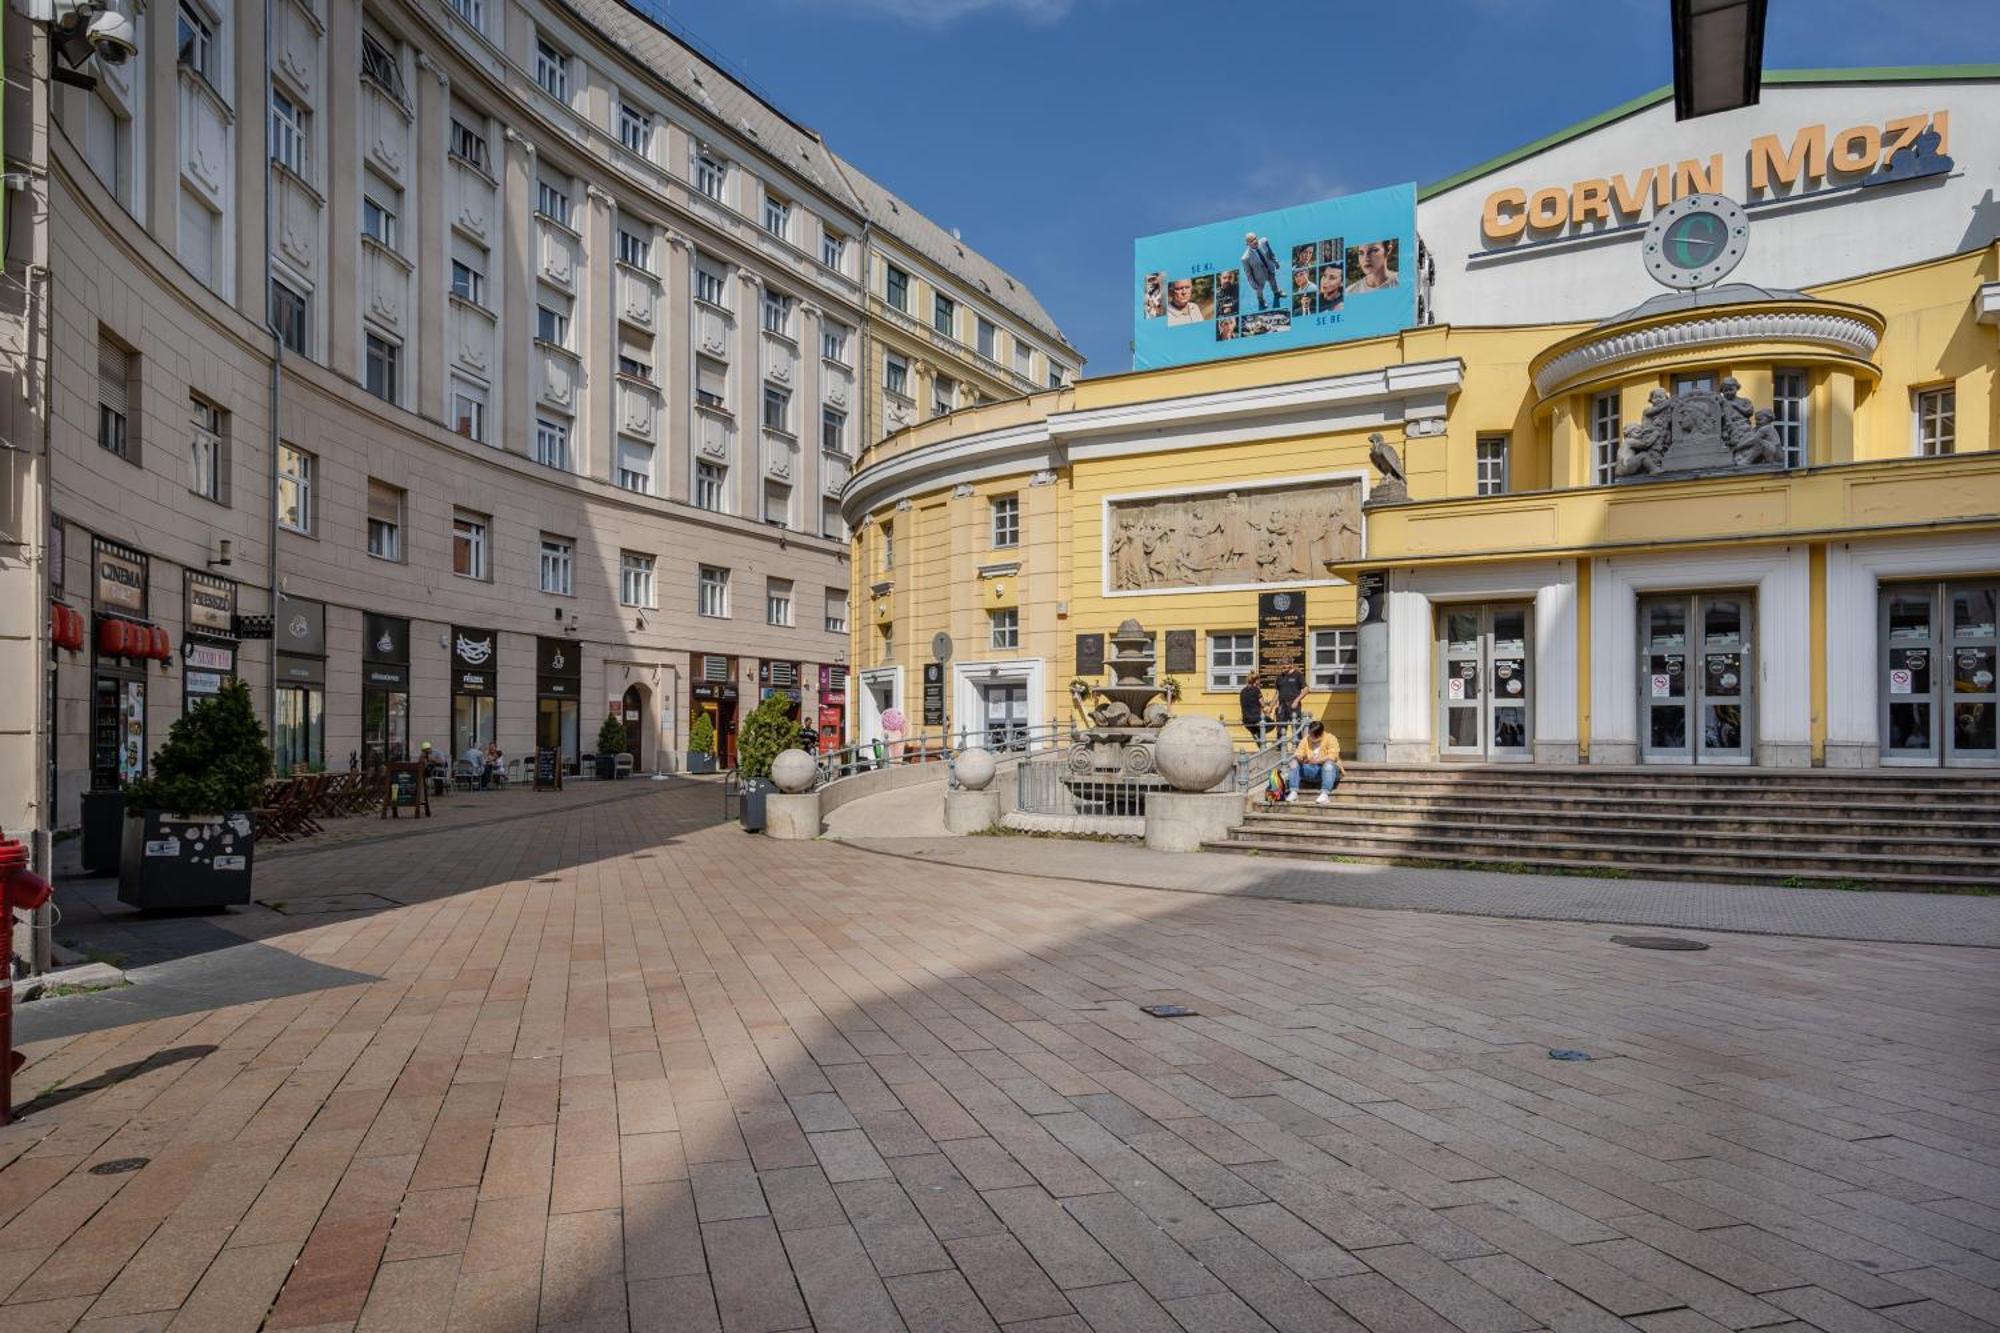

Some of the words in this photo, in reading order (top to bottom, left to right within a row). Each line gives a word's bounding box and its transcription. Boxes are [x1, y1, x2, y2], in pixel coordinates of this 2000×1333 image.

[1483, 153, 1723, 237] CORVIN
[1751, 110, 1948, 188] MOZI
[101, 562, 142, 588] CINEMA
